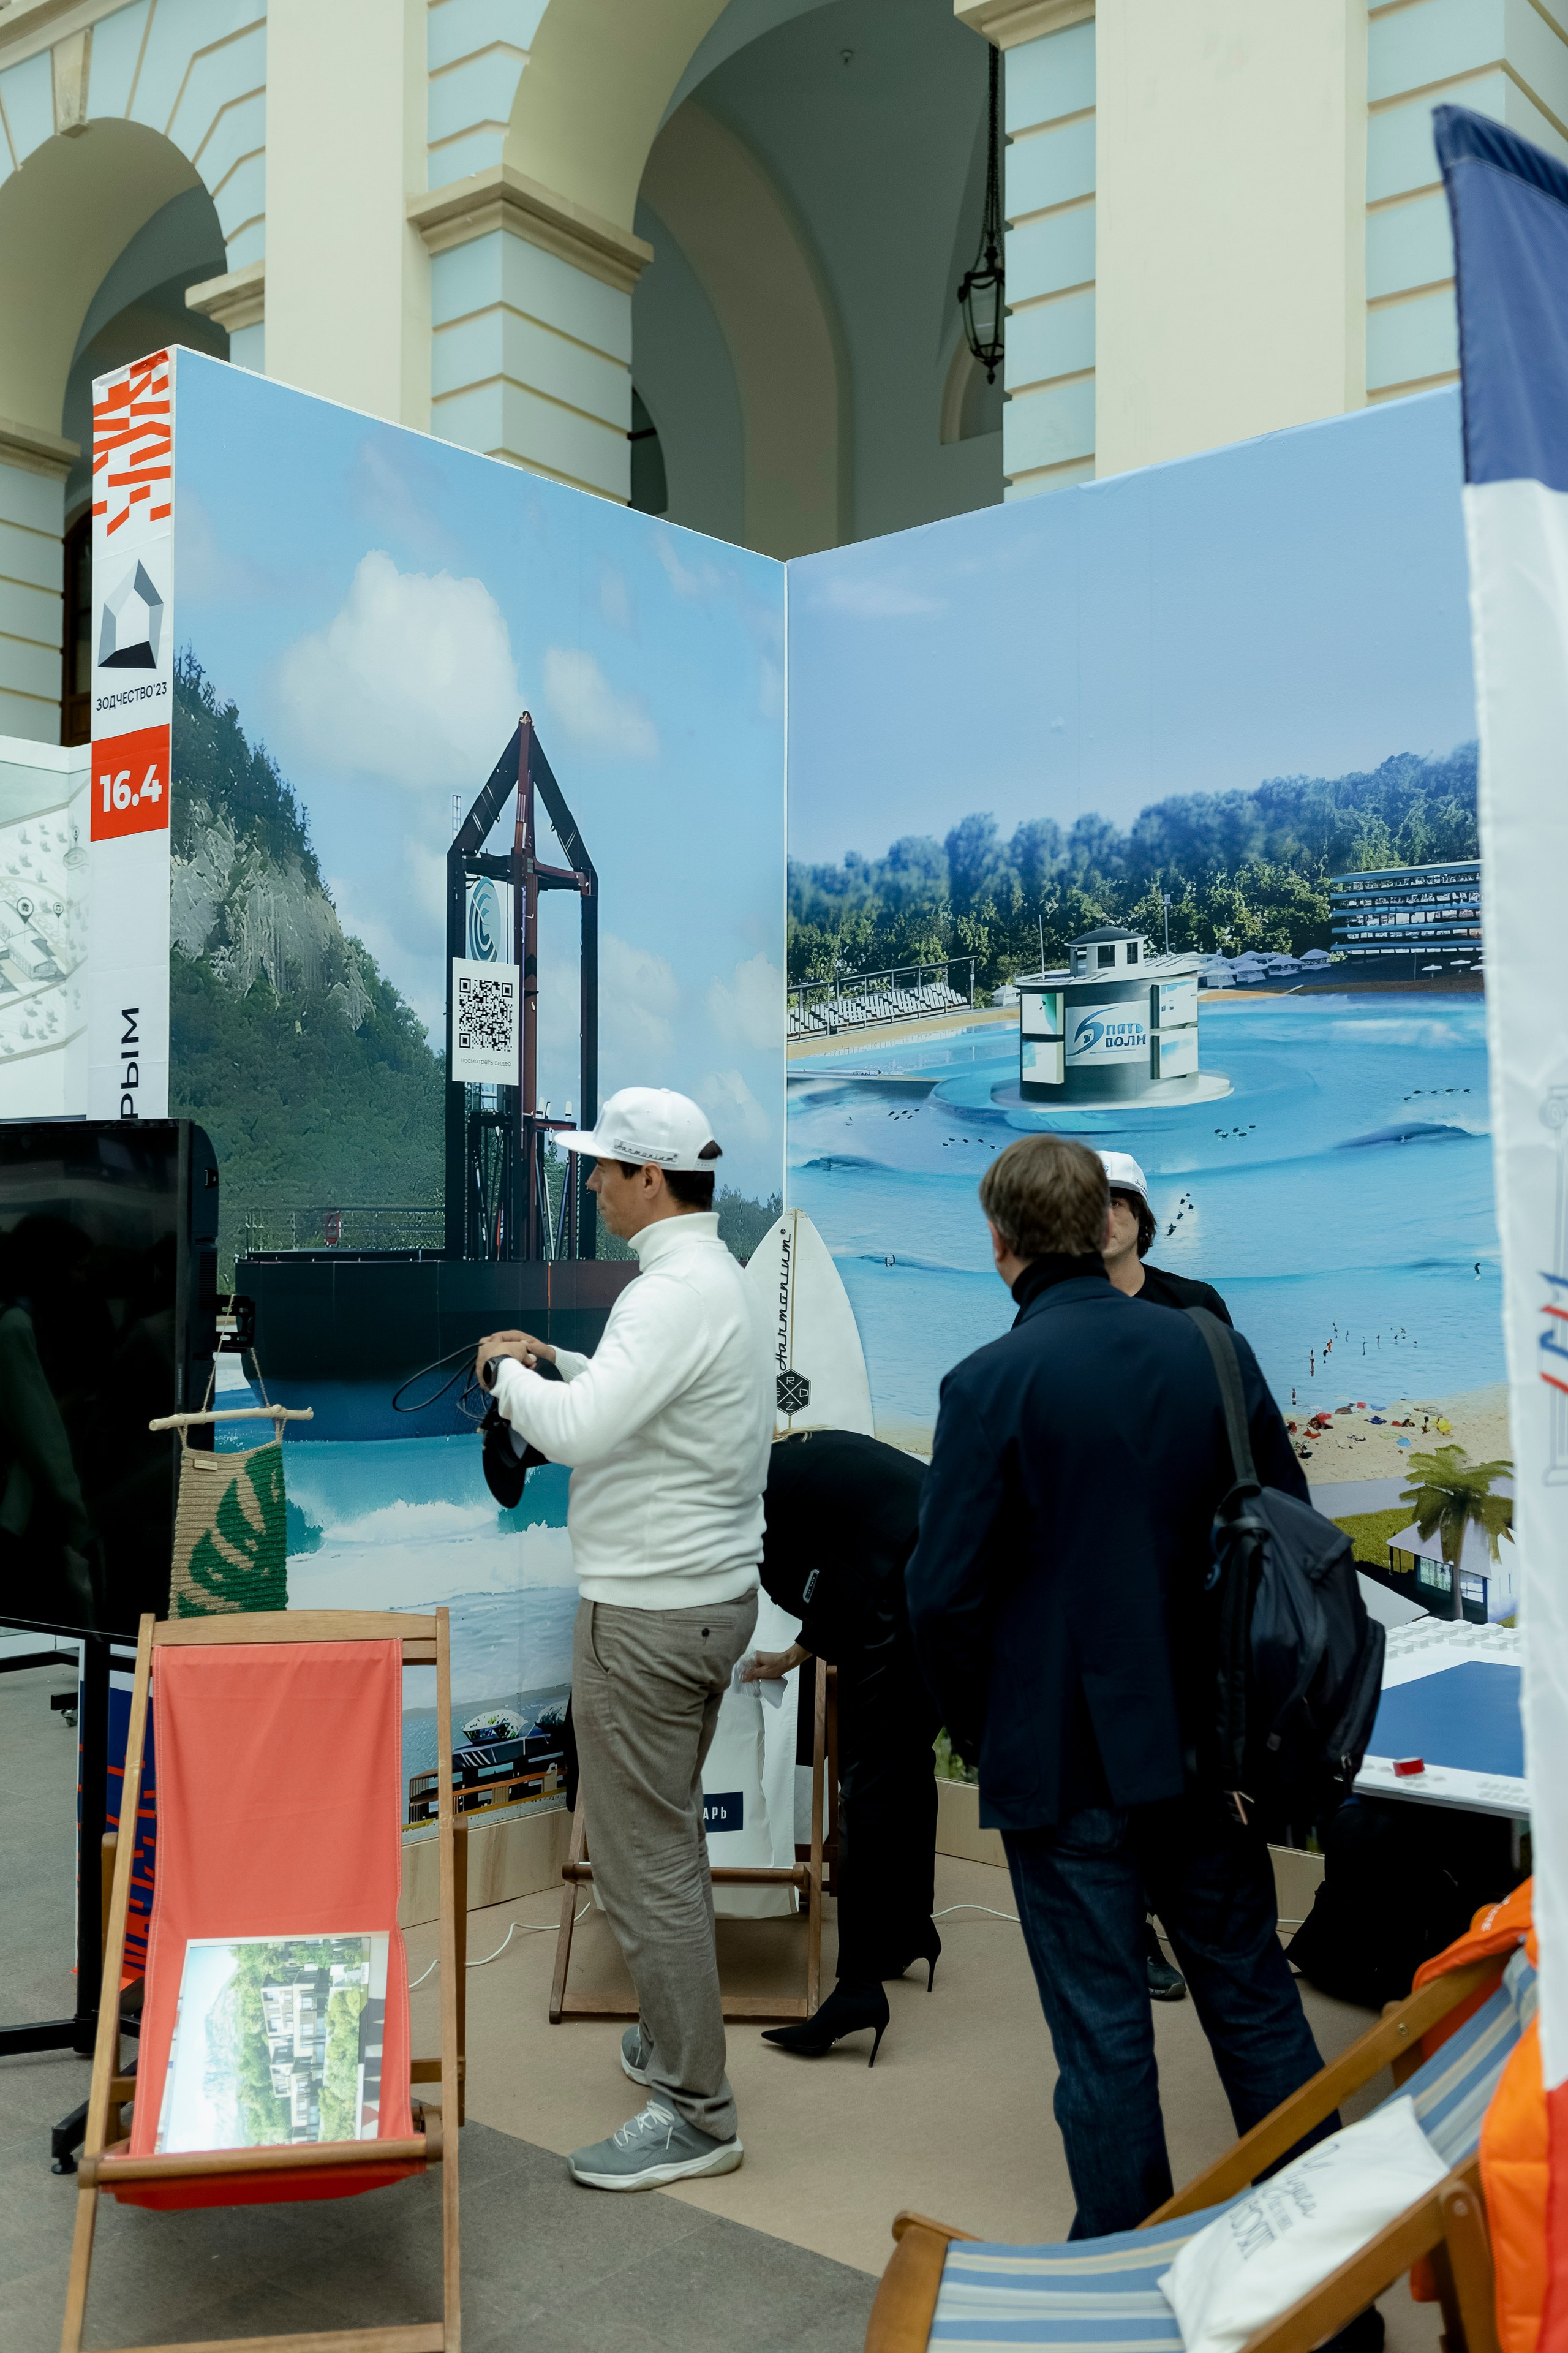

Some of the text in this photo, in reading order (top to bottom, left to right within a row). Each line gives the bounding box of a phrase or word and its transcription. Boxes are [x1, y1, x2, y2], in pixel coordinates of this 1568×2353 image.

[96, 681, 167, 711] ЗОДЧЕСТВО'23
[99, 763, 162, 813] 16.4
[460, 1057, 494, 1066] посмотреть
